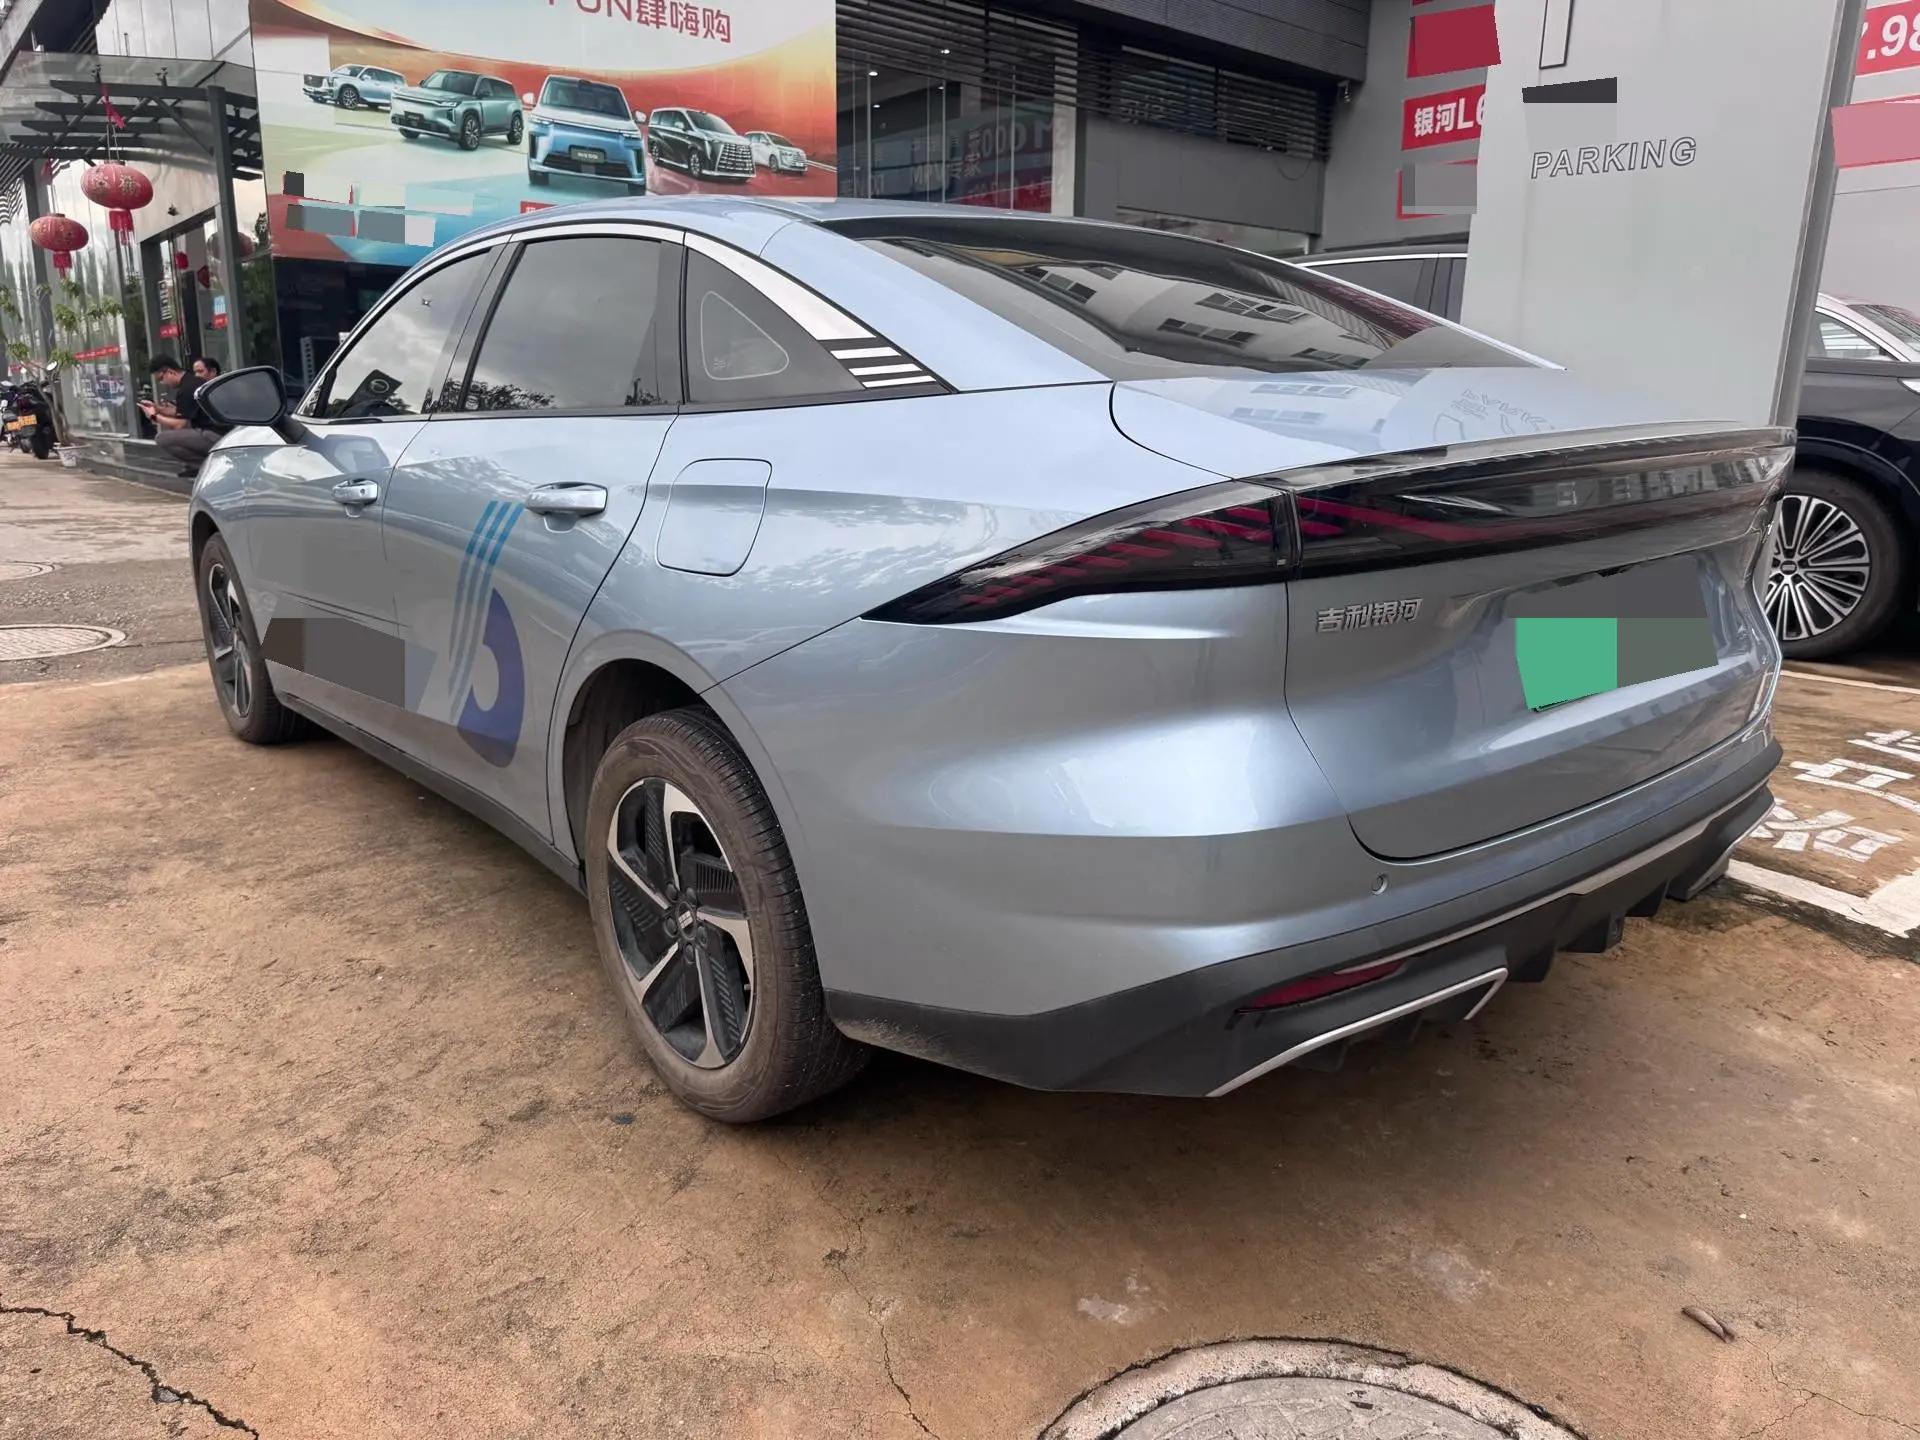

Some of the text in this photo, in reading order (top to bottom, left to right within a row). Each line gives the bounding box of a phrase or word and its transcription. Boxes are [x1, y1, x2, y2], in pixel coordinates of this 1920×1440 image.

[1531, 136, 1697, 179] PARKING
[1317, 598, 1423, 632] 吉利银河
